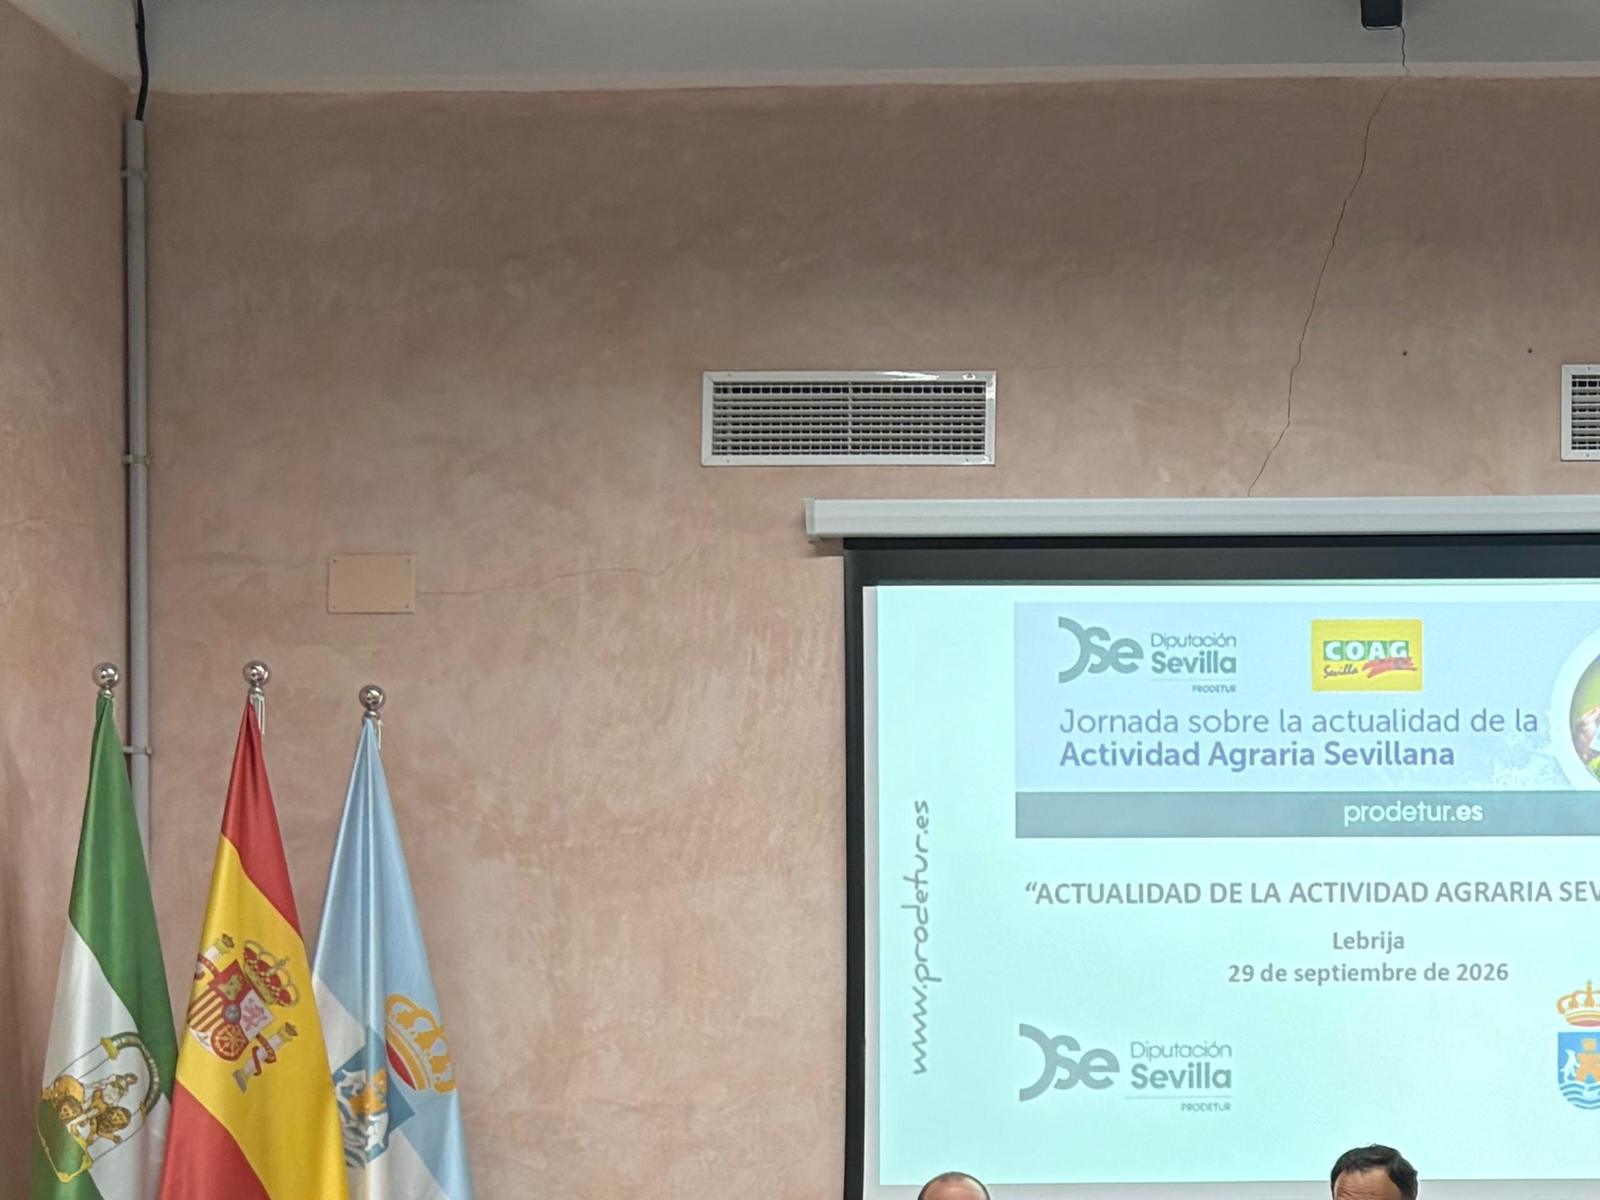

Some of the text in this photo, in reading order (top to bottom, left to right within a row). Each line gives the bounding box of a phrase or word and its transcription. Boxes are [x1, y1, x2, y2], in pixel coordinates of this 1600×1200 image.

[1151, 631, 1236, 651] Diputación
[1324, 641, 1409, 660] COAG
[1151, 651, 1237, 674] Sevilla
[1323, 663, 1359, 678] Sevilla
[1060, 708, 1538, 733] Jornada sobre la actualidad de la
[1060, 740, 1454, 772] Actividad Agraria Sevillana
[1344, 800, 1483, 825] prodetur.es
[1024, 882, 1201, 904] “ACTUALIDAD
[1210, 882, 1243, 903] DE
[1250, 882, 1281, 903] LA
[1289, 881, 1428, 903] ACTIVIDAD
[1435, 881, 1553, 903] AGRARIA
[900, 800, 943, 1075] www.prodetur.es
[1333, 931, 1405, 954] Lebrija
[1228, 963, 1509, 986] 29 de septiembre de 2026
[1130, 1041, 1232, 1062] Diputación
[1131, 1062, 1232, 1089] Sevilla
[1181, 1103, 1231, 1112] PRODETUR
